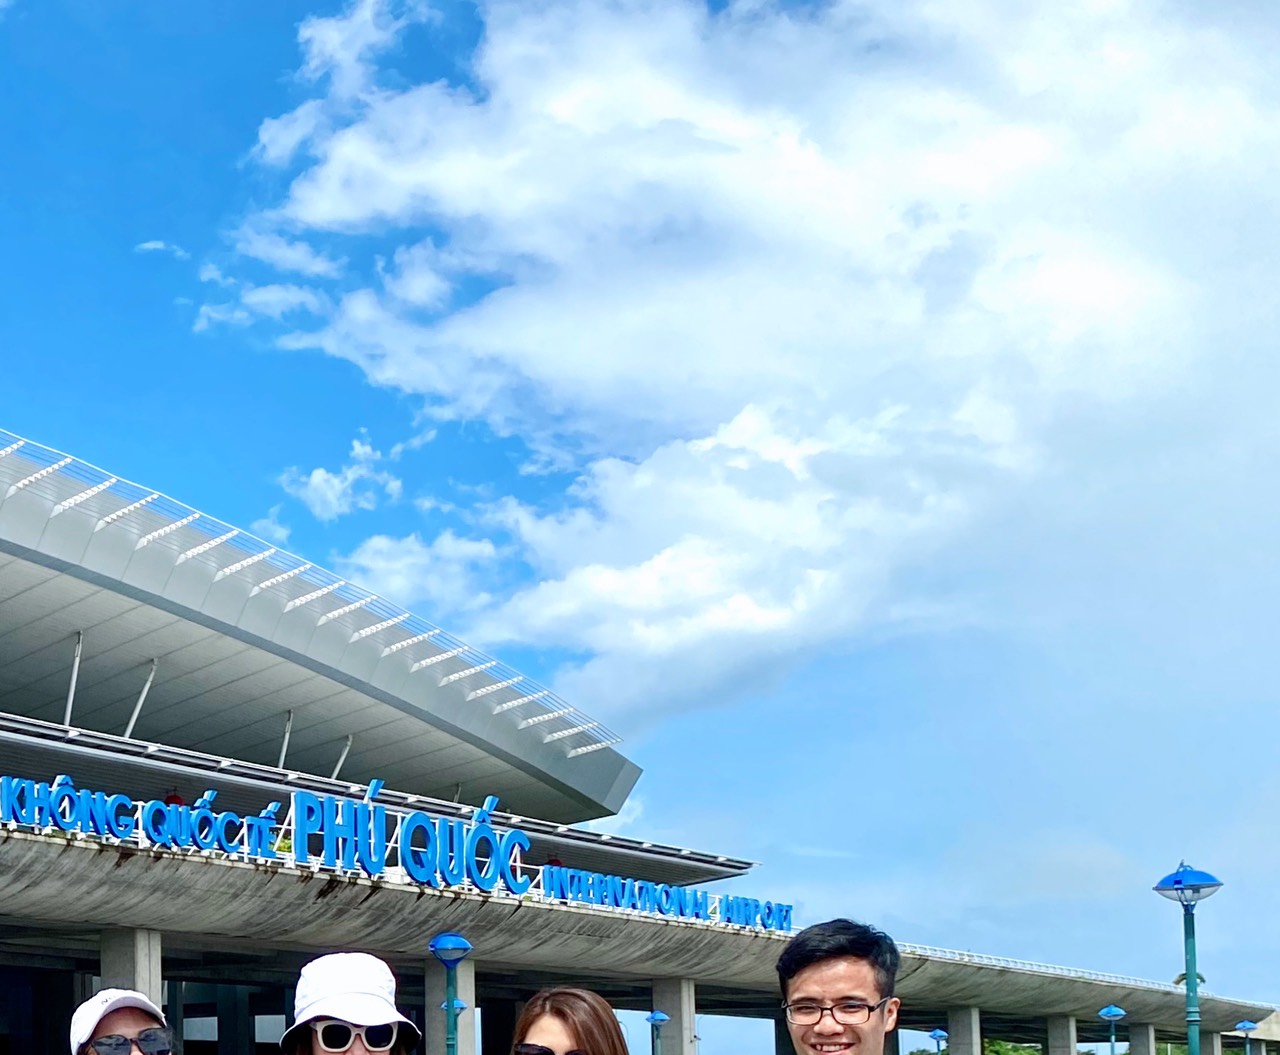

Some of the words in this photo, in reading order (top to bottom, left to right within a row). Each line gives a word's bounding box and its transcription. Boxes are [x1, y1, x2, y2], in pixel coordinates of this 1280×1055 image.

[0, 774, 135, 839] KHÔNG
[142, 790, 241, 853] QUỐC
[245, 801, 282, 858] TẾ
[294, 779, 387, 876] PHÚ
[401, 795, 531, 894] QUỐC
[543, 864, 711, 920] INTERNATIONAL
[721, 894, 793, 931] AIRPORT
